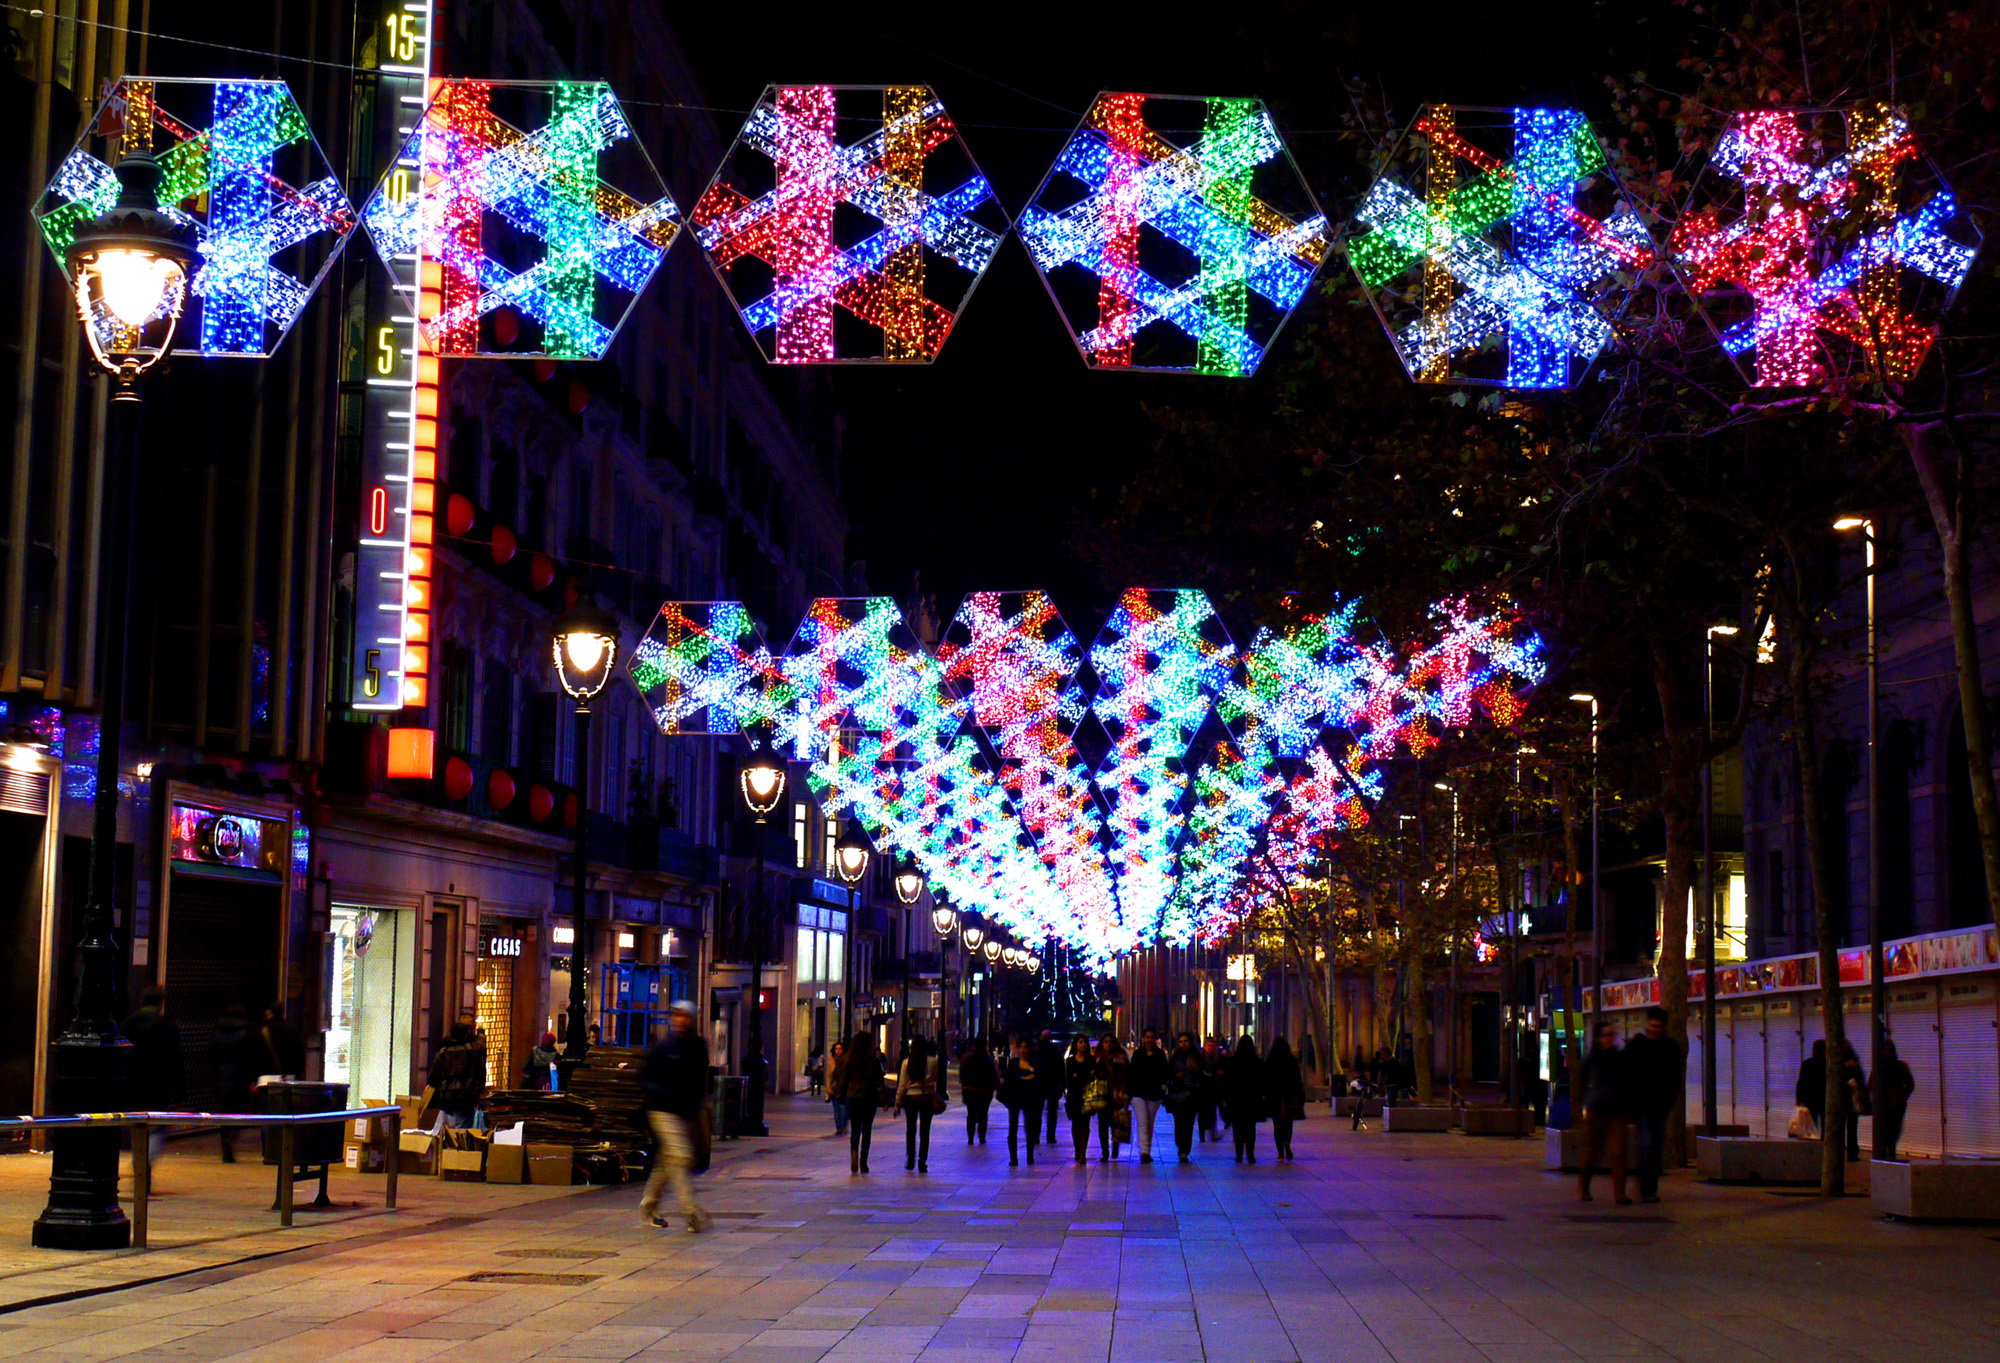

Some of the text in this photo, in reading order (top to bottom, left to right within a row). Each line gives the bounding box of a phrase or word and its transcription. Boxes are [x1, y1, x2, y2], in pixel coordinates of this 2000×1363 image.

[386, 14, 415, 61] 15
[383, 169, 408, 216] 10
[377, 327, 394, 375] 5
[371, 487, 386, 535] 0
[363, 649, 381, 697] 5
[491, 937, 521, 956] CASAS
